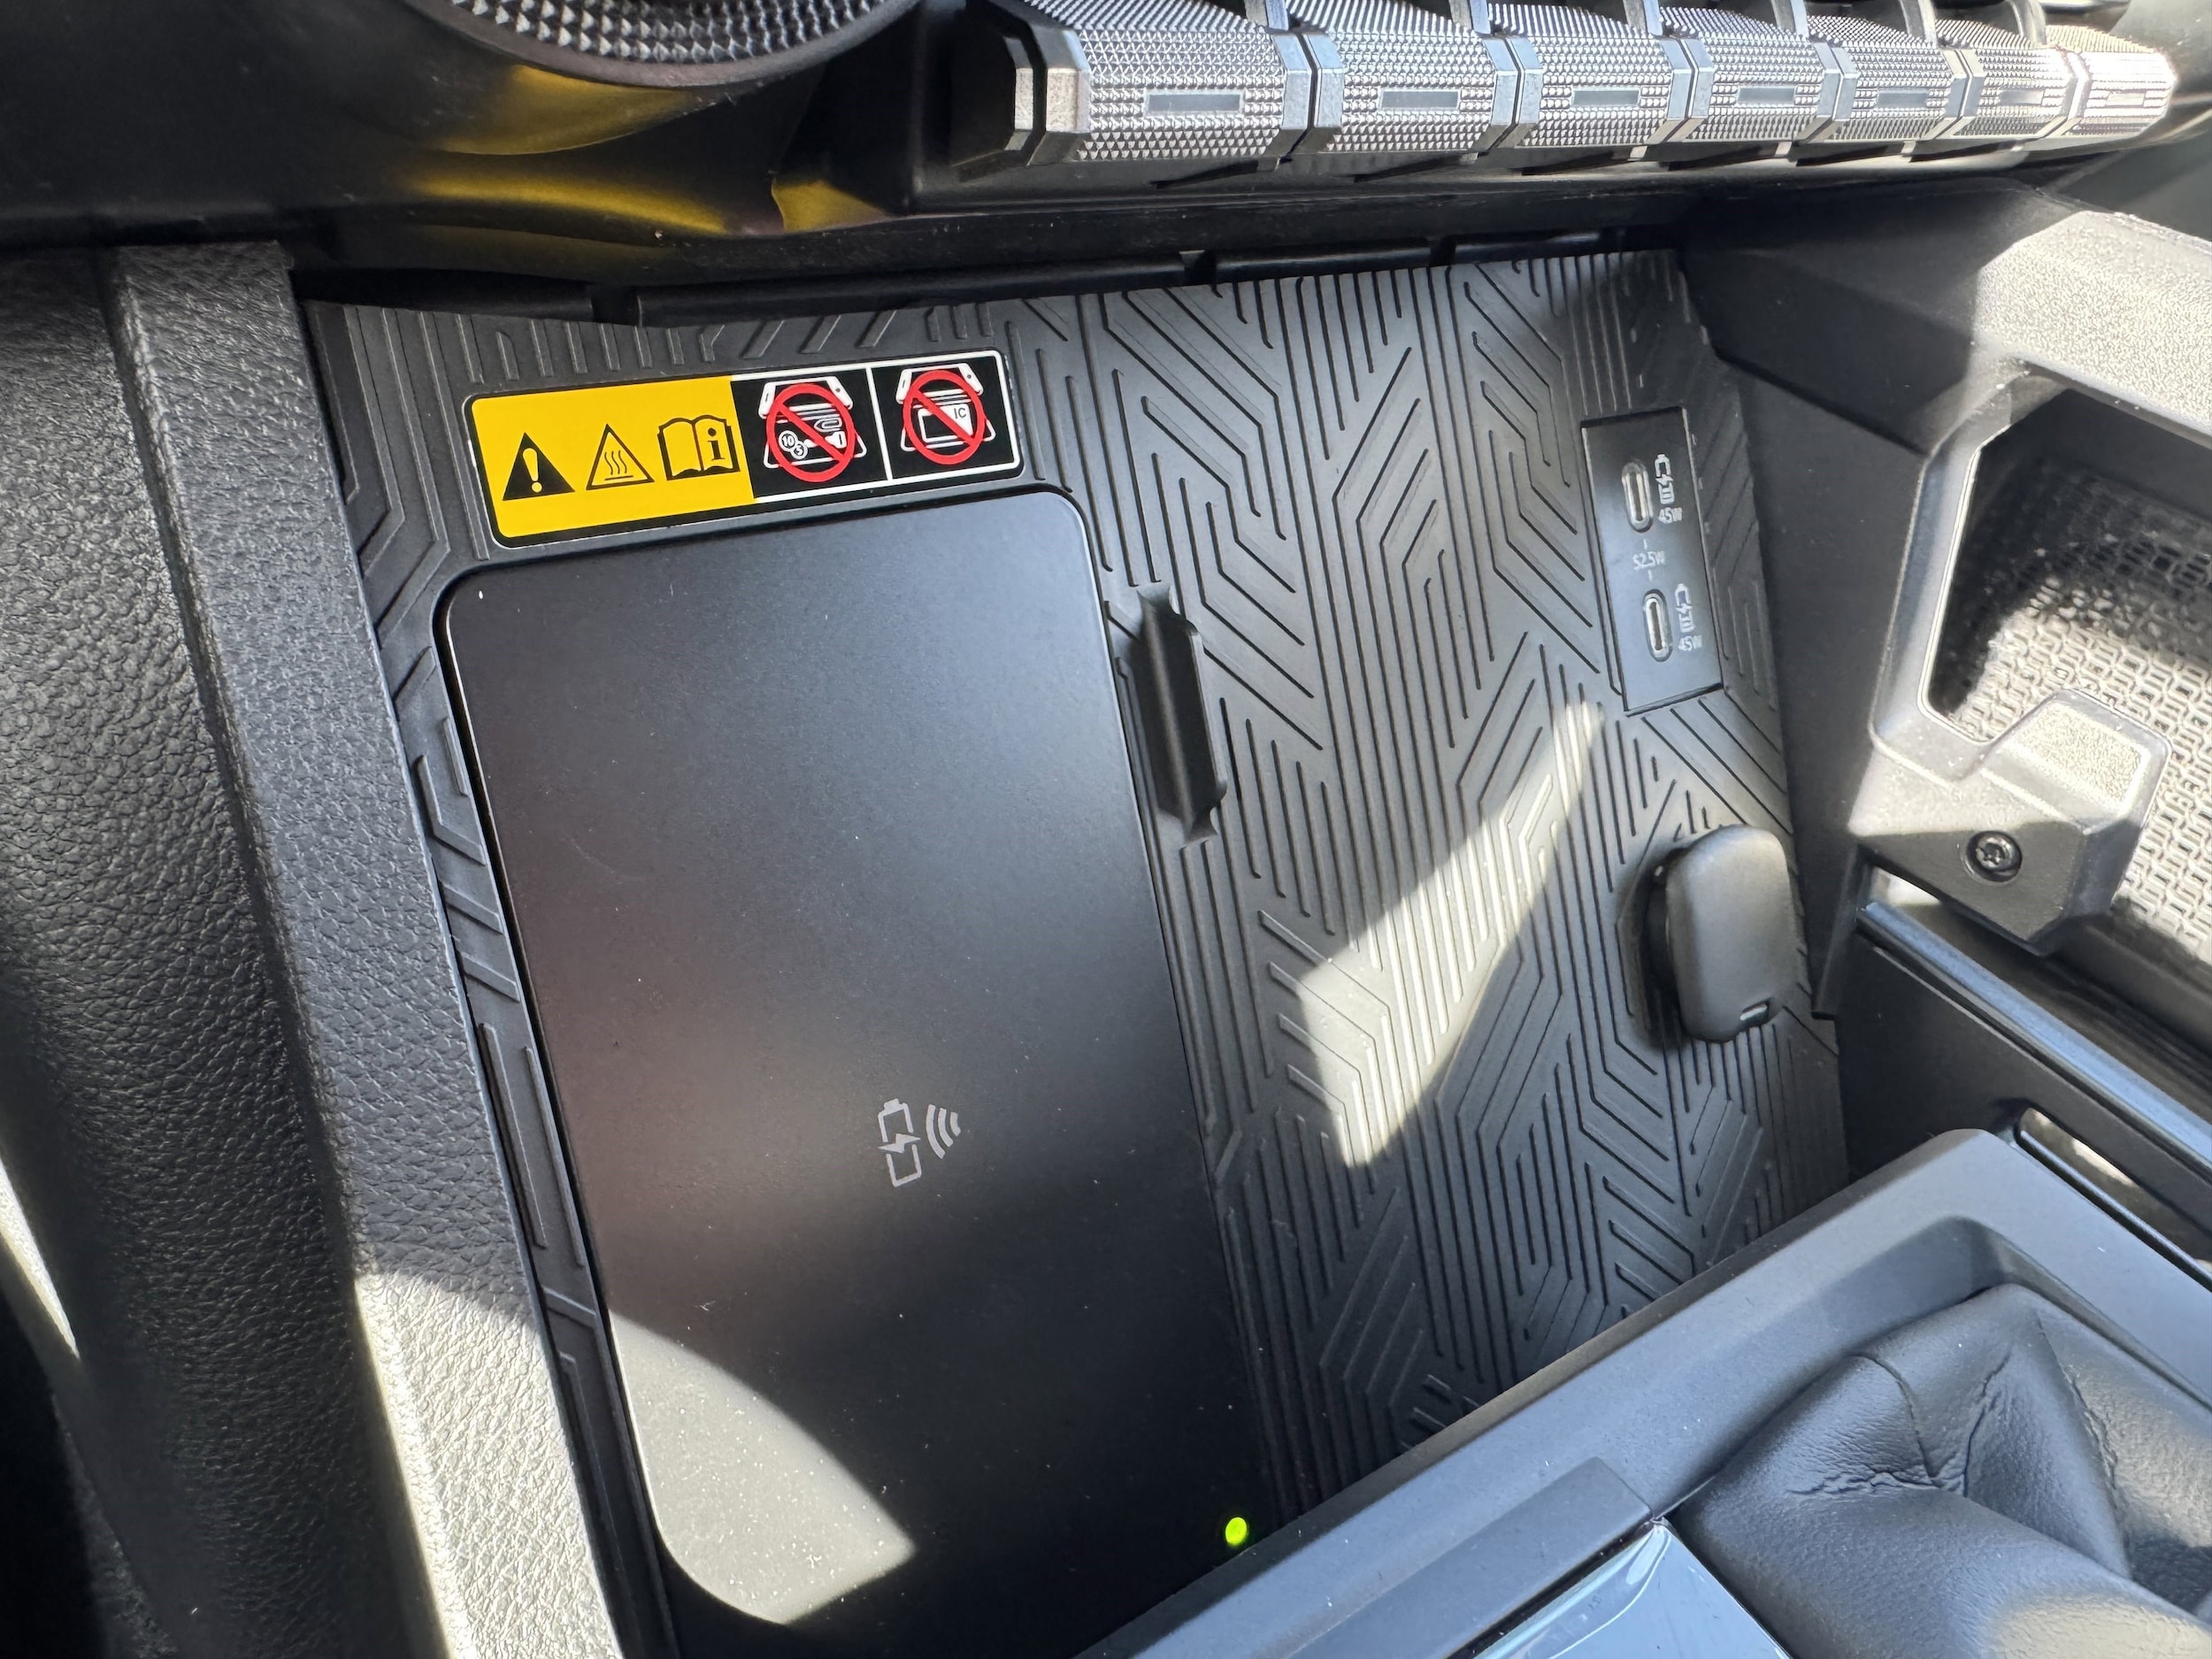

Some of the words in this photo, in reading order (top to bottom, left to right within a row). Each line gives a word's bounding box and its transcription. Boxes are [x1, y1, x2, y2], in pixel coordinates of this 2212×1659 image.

[954, 407, 967, 419] IC
[782, 435, 795, 448] 10
[1658, 507, 1683, 524] 45W
[1678, 634, 1702, 652] 45W
